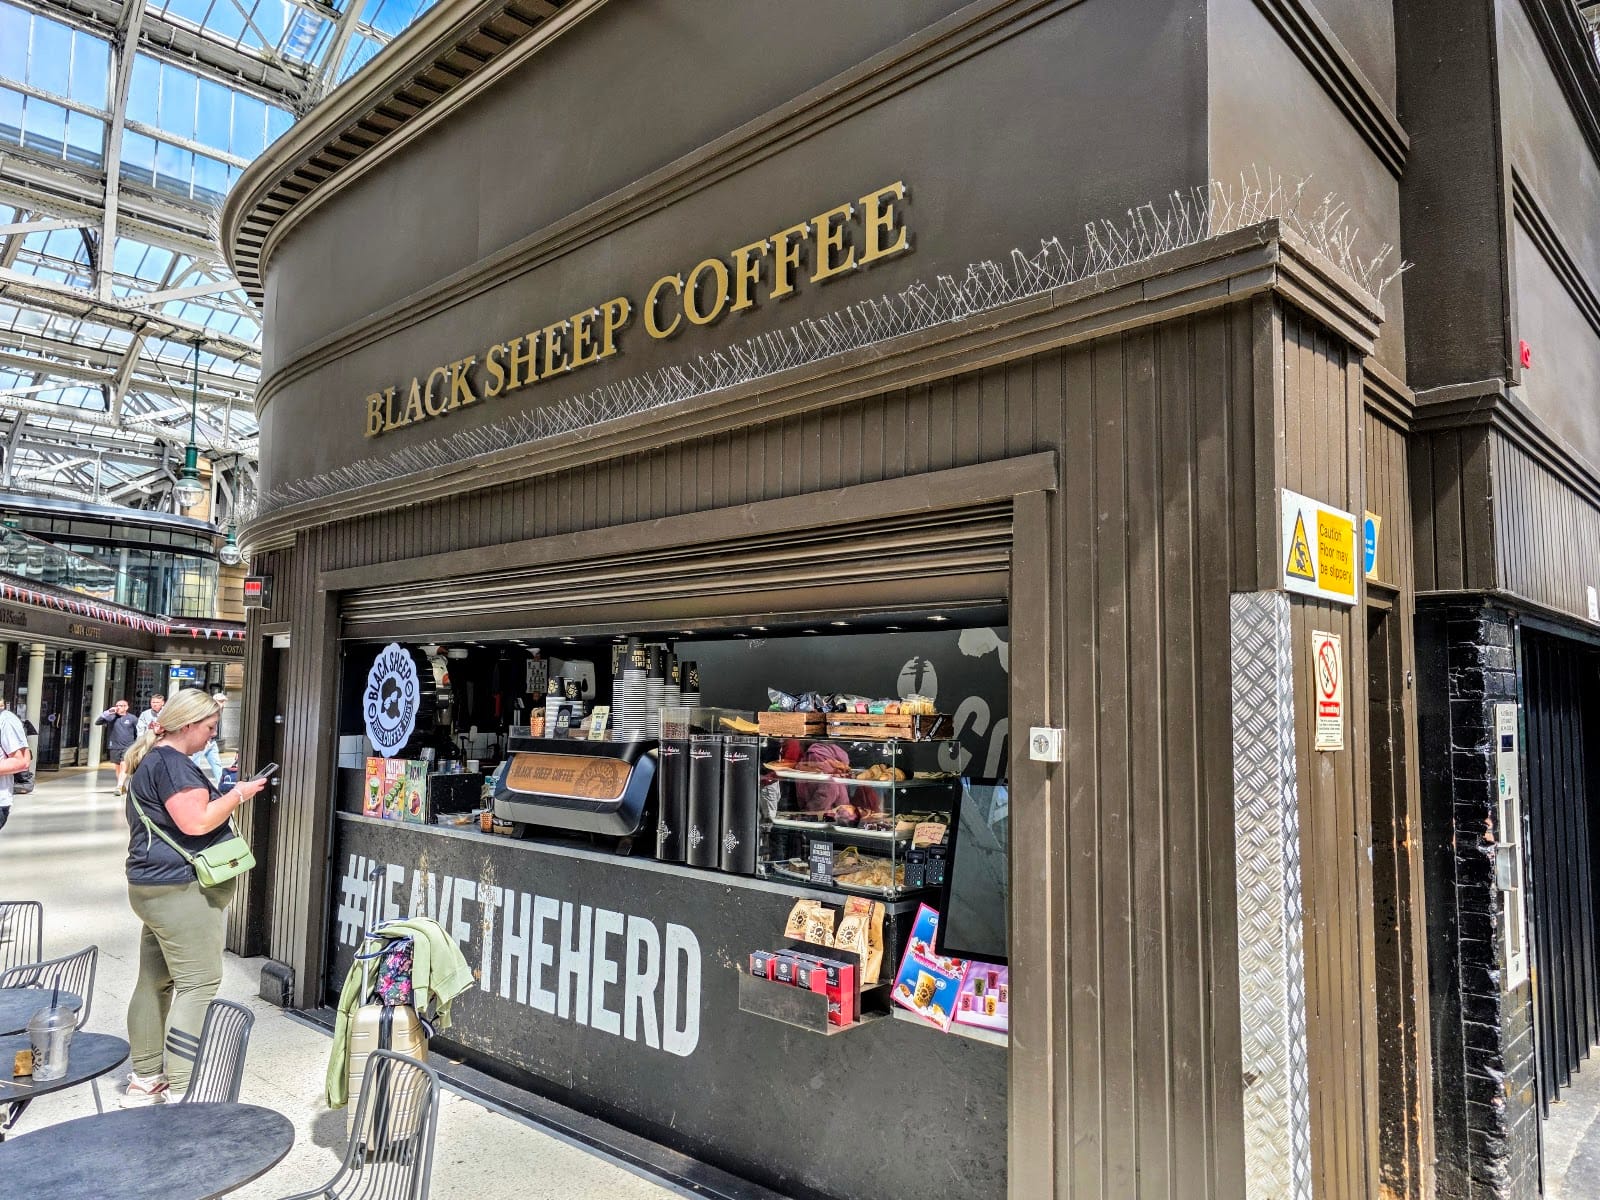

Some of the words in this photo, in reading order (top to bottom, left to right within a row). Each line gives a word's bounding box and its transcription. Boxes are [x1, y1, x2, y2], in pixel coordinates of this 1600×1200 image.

[363, 354, 477, 438] BLACK
[483, 296, 631, 398] SHEEP
[643, 180, 910, 339] COFFEE
[1319, 523, 1342, 541] Caution
[1320, 542, 1335, 558] Floor
[1336, 549, 1349, 565] may
[1320, 562, 1328, 575] be
[1329, 564, 1352, 584] slippery
[221, 644, 243, 655] COSTA
[368, 654, 390, 701] BLACK
[389, 651, 412, 681] SHEEP
